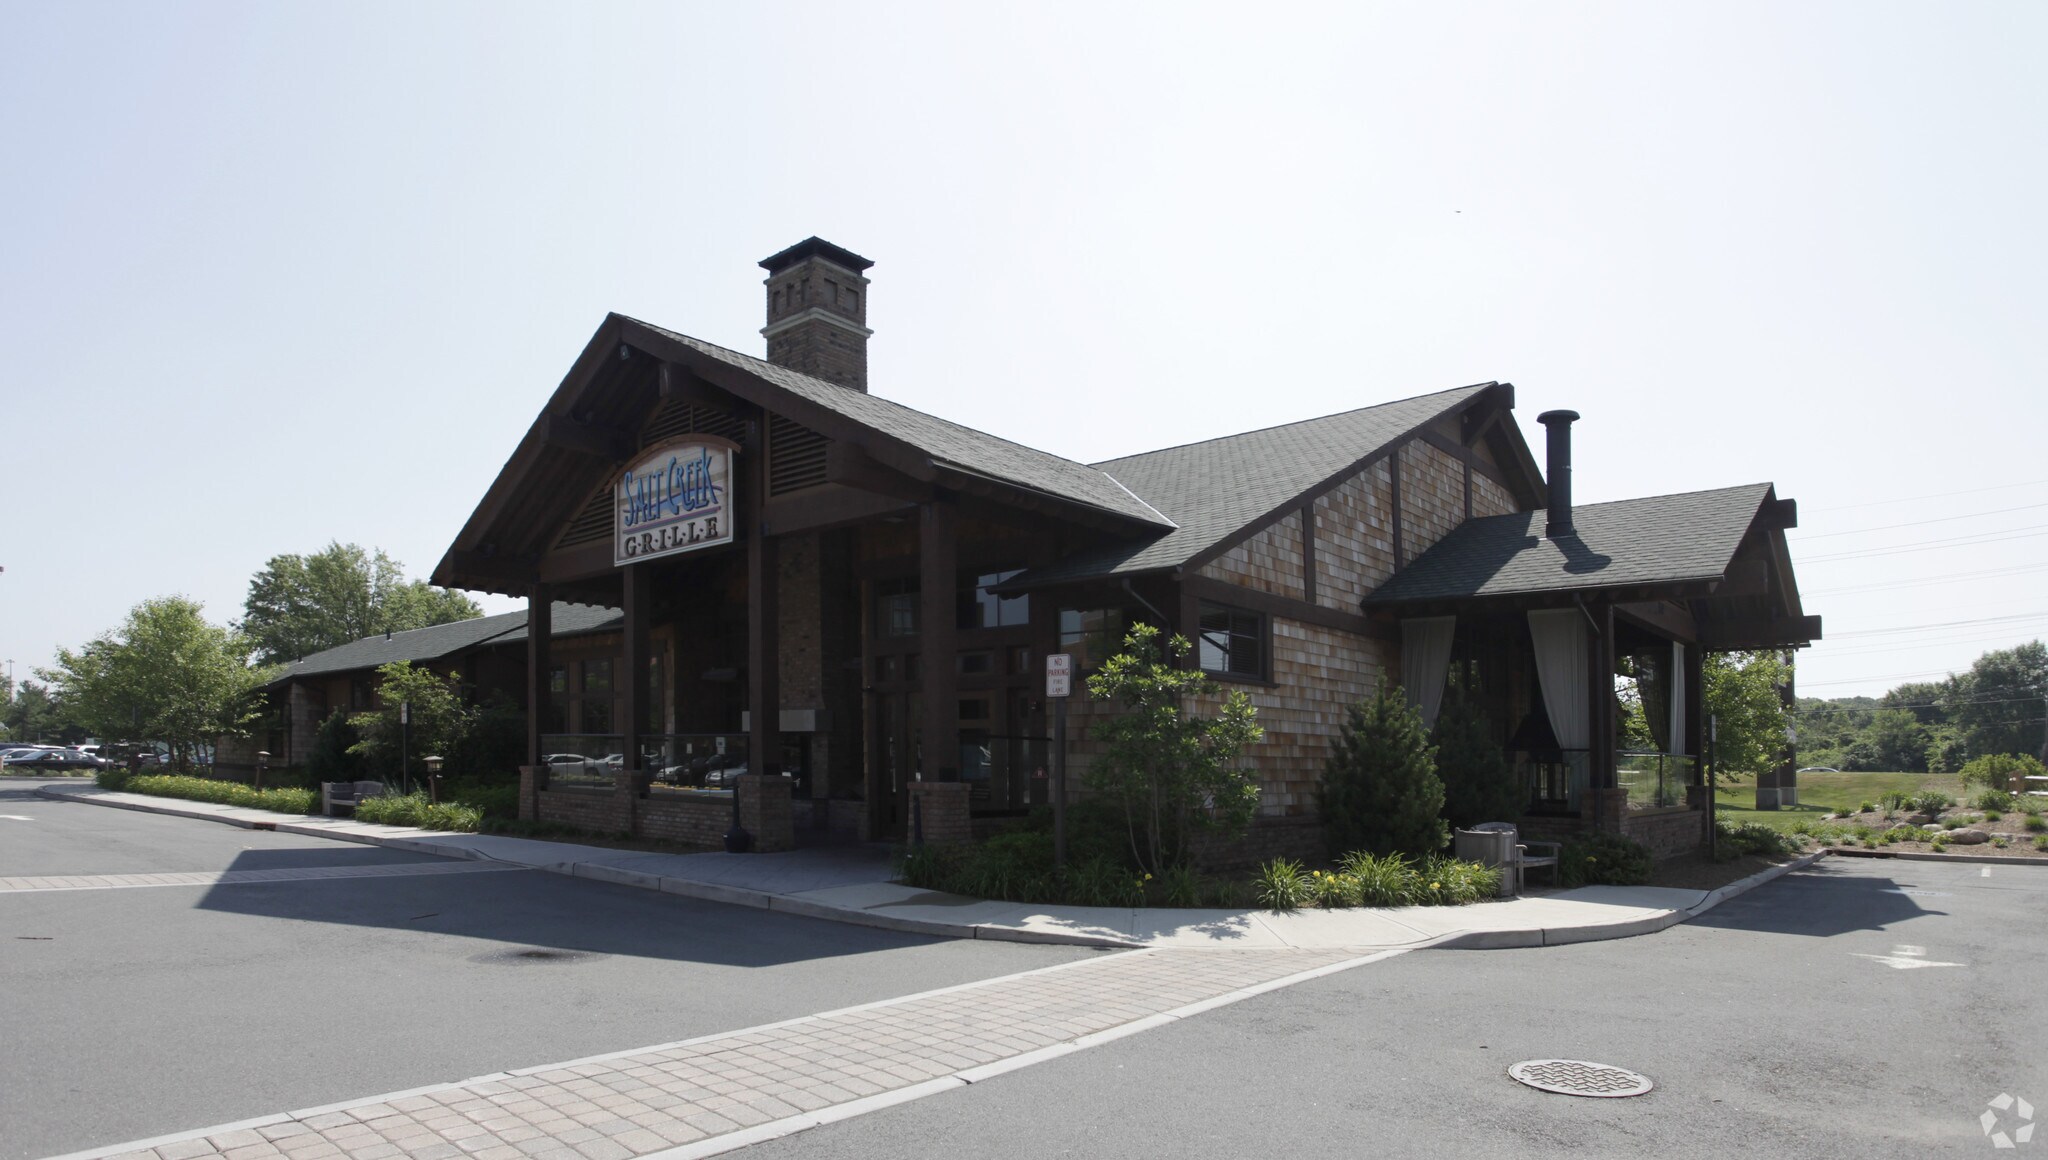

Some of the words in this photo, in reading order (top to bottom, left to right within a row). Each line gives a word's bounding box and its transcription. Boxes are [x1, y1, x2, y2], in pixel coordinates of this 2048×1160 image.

[624, 470, 663, 527] SALT
[667, 447, 718, 515] CREEK
[1054, 657, 1063, 666] NO
[1048, 668, 1069, 677] PARKING
